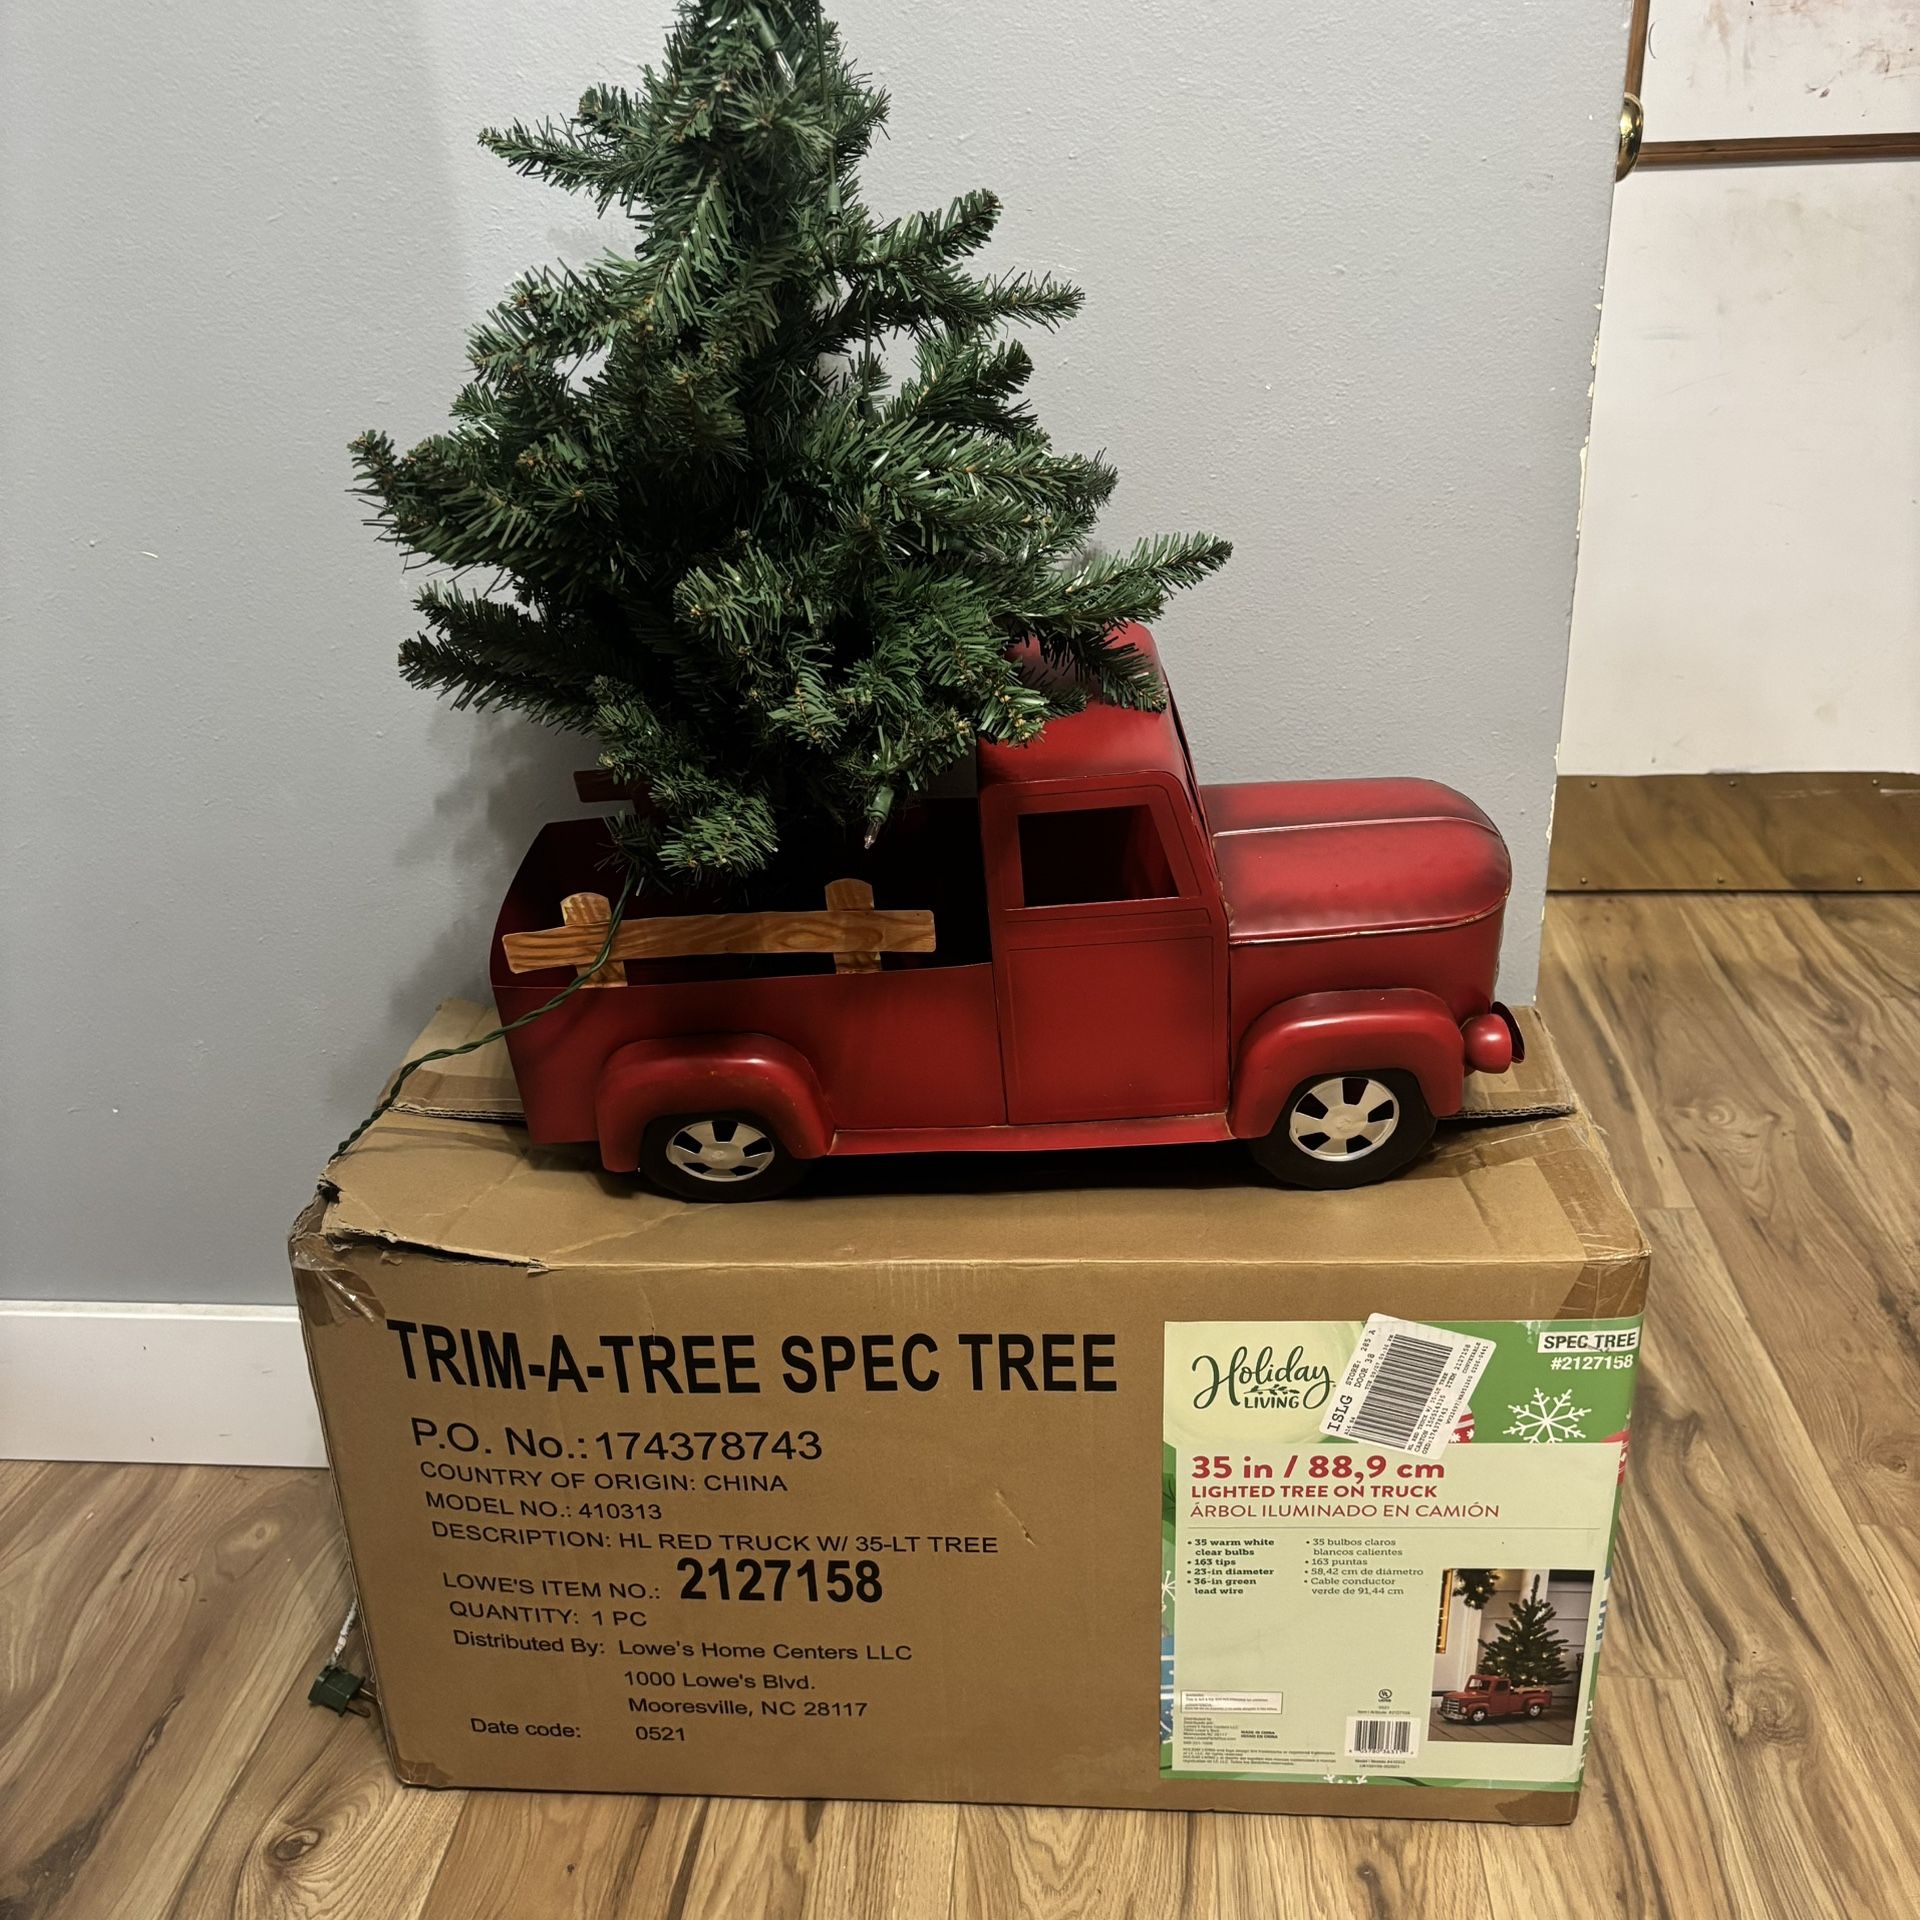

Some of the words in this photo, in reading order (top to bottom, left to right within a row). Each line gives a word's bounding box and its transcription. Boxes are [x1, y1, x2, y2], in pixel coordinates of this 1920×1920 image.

[1543, 1334, 1589, 1349] SPEC
[1594, 1332, 1637, 1349] TREE
[386, 1319, 761, 1394] TRIM-A-TREE
[781, 1333, 940, 1394] SPEC
[958, 1333, 1118, 1392] TREE
[1344, 1359, 1361, 1386] STORE:
[1359, 1337, 1372, 1351] 285
[1550, 1354, 1634, 1371] #2127158
[1191, 1345, 1337, 1410] Holiday
[1352, 1366, 1368, 1388] DOOR
[1364, 1352, 1375, 1363] 38
[1244, 1396, 1300, 1409] LIVING
[1326, 1393, 1353, 1432] ISLG
[1412, 1429, 1429, 1452] CARTON
[1444, 1372, 1457, 1388] ITEM
[411, 1417, 492, 1454] P.O.
[420, 1461, 543, 1488] COUNTRY
[551, 1473, 586, 1489] OF
[594, 1474, 695, 1491] ORIGIN:
[703, 1475, 788, 1492] CHINA
[1191, 1456, 1232, 1479] 35
[1243, 1456, 1274, 1479] in
[1283, 1455, 1299, 1479] /
[1308, 1455, 1387, 1484] 88,9
[1397, 1462, 1446, 1479] cm
[1191, 1485, 1276, 1499] LIGHTED
[1280, 1485, 1329, 1498] TREE
[1333, 1485, 1365, 1499] ON
[1370, 1485, 1438, 1498] TRUCK
[425, 1491, 514, 1516] MODEL
[520, 1501, 571, 1519] NO.:
[578, 1503, 663, 1520] 410313
[1190, 1501, 1257, 1518] ÁRBOL
[1262, 1504, 1378, 1518] ILUMINADO
[1384, 1504, 1410, 1518] EN
[1415, 1501, 1500, 1518] CAMIÓN
[432, 1521, 611, 1548] DESCRIPTION:
[619, 1532, 652, 1549] HL
[658, 1533, 712, 1550] RED
[719, 1535, 809, 1551] TRUCK
[816, 1536, 849, 1551] W/
[855, 1536, 920, 1552] 35-LT
[928, 1537, 999, 1553] TREE
[1194, 1538, 1207, 1546] 35
[1243, 1538, 1275, 1546] white
[1312, 1538, 1325, 1546] 35
[1327, 1538, 1362, 1546] bulbos
[1364, 1538, 1396, 1546] claros
[1195, 1548, 1222, 1556] clear
[1225, 1548, 1255, 1556] bulbs
[1313, 1548, 1354, 1556] blancos
[1356, 1548, 1403, 1556] calientes
[1194, 1558, 1213, 1566] 163
[1215, 1558, 1236, 1567] tips
[1310, 1567, 1339, 1576] 58,42
[1311, 1558, 1329, 1566] 163
[1331, 1559, 1368, 1567] puntas
[442, 1572, 535, 1595] LOWE'S
[542, 1580, 602, 1598] ITEM
[609, 1583, 661, 1600] NO.:
[676, 1557, 884, 1603] 2127158
[1193, 1577, 1223, 1585] 36-in
[1225, 1578, 1257, 1586] green
[1310, 1577, 1340, 1585] Cable
[1342, 1577, 1396, 1585] conductor
[1194, 1587, 1217, 1595] lead
[1219, 1587, 1244, 1595] wire
[1311, 1587, 1340, 1595] verde
[1342, 1587, 1356, 1595] de
[1357, 1587, 1385, 1596] 91,44
[449, 1600, 580, 1626] QUANTITY:
[593, 1610, 603, 1626] 1
[613, 1611, 648, 1628] PC
[453, 1629, 565, 1654] Distributed
[570, 1639, 606, 1658] By:
[619, 1640, 695, 1659] Lowe's
[702, 1642, 766, 1660] Home
[773, 1644, 859, 1661] Centers
[866, 1645, 913, 1662] LLC
[624, 1671, 676, 1688] 1000
[683, 1672, 757, 1690] Lowe's
[763, 1673, 817, 1691] Blvd.
[628, 1697, 753, 1718] Mooresville,
[761, 1701, 796, 1717] NC
[804, 1702, 869, 1718] 28117
[471, 1717, 519, 1736] Date
[525, 1721, 582, 1739] code:
[635, 1726, 687, 1742] 0521
